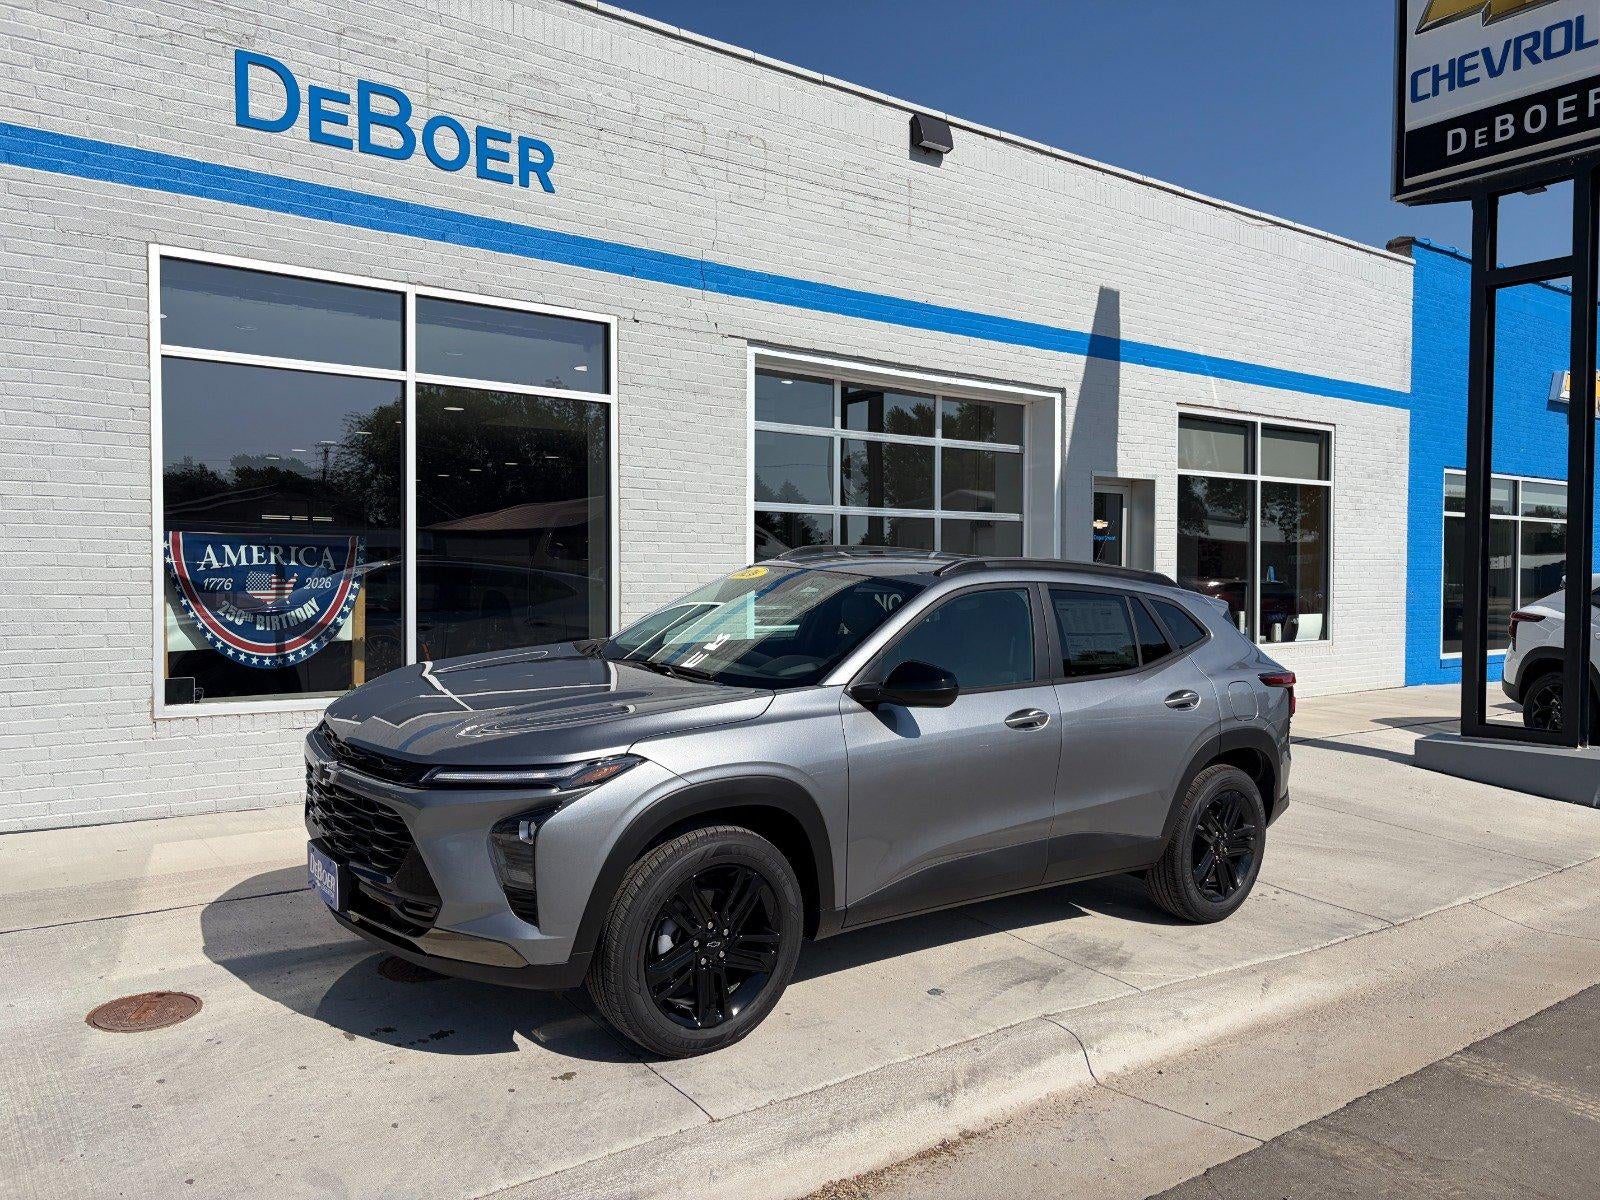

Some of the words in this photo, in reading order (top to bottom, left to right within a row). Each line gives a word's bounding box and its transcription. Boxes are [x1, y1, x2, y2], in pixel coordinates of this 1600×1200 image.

[1411, 15, 1599, 103] CHEVROL
[196, 543, 337, 572] AMERICA
[202, 577, 234, 591] 1776
[303, 576, 332, 590] 2026
[255, 596, 320, 631] BIRTHDAY
